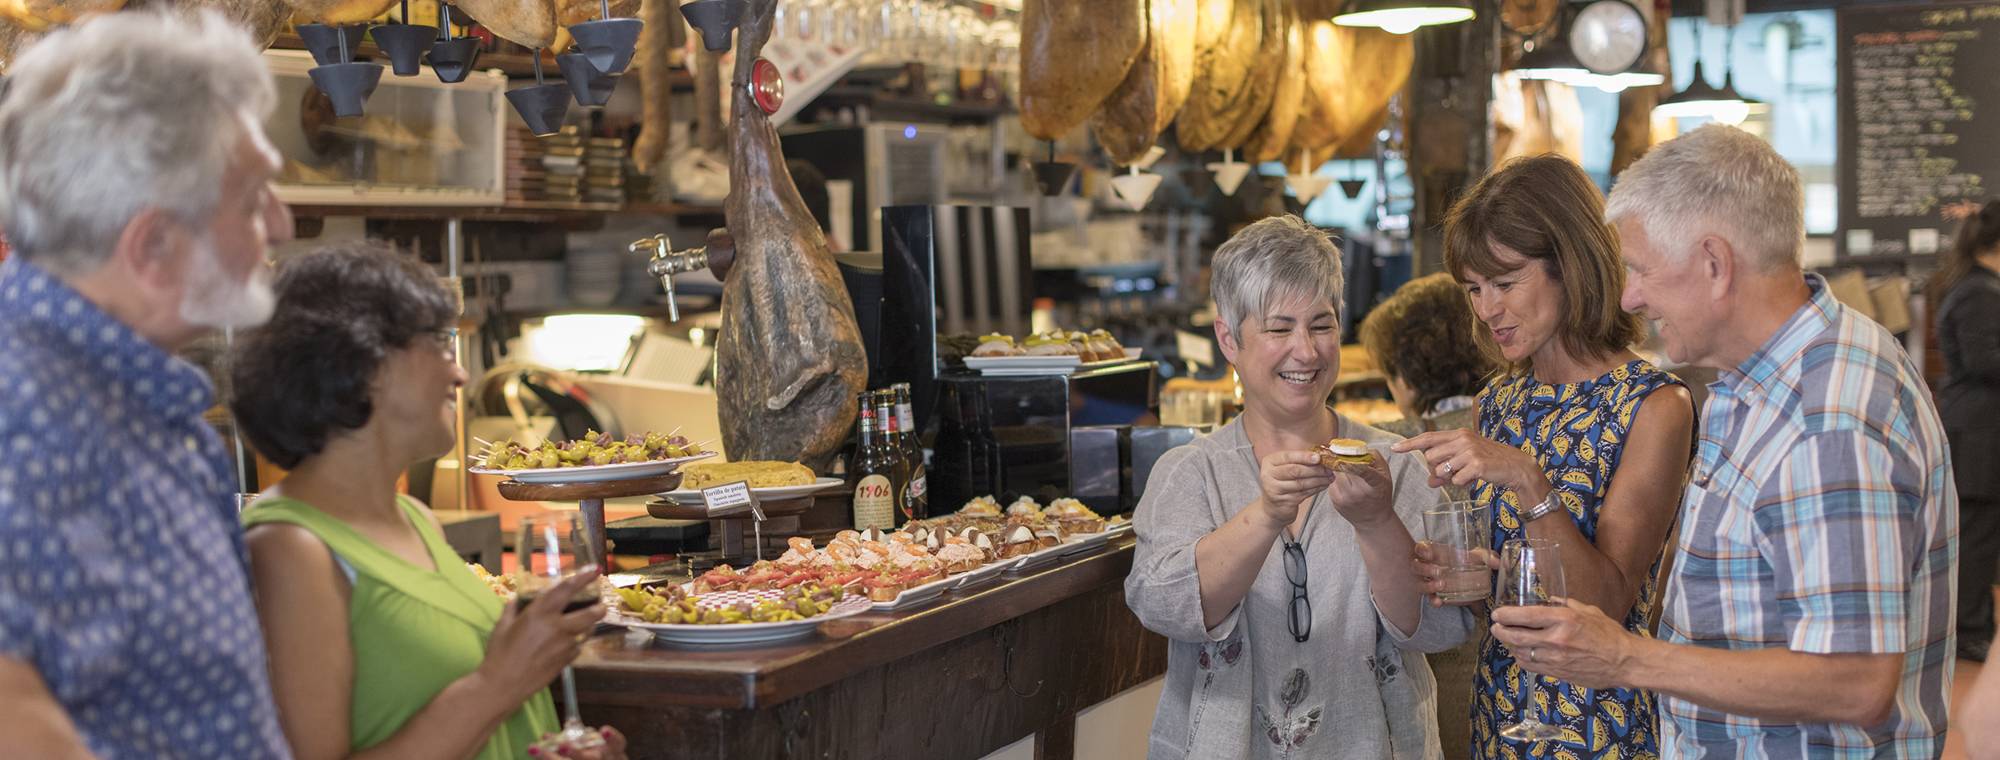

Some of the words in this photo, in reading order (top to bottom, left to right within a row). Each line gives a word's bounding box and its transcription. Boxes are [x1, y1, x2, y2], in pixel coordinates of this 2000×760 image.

[859, 409, 876, 418] 1906
[705, 489, 723, 497] Tortilla
[731, 485, 746, 493] patata
[860, 484, 889, 498] 1906
